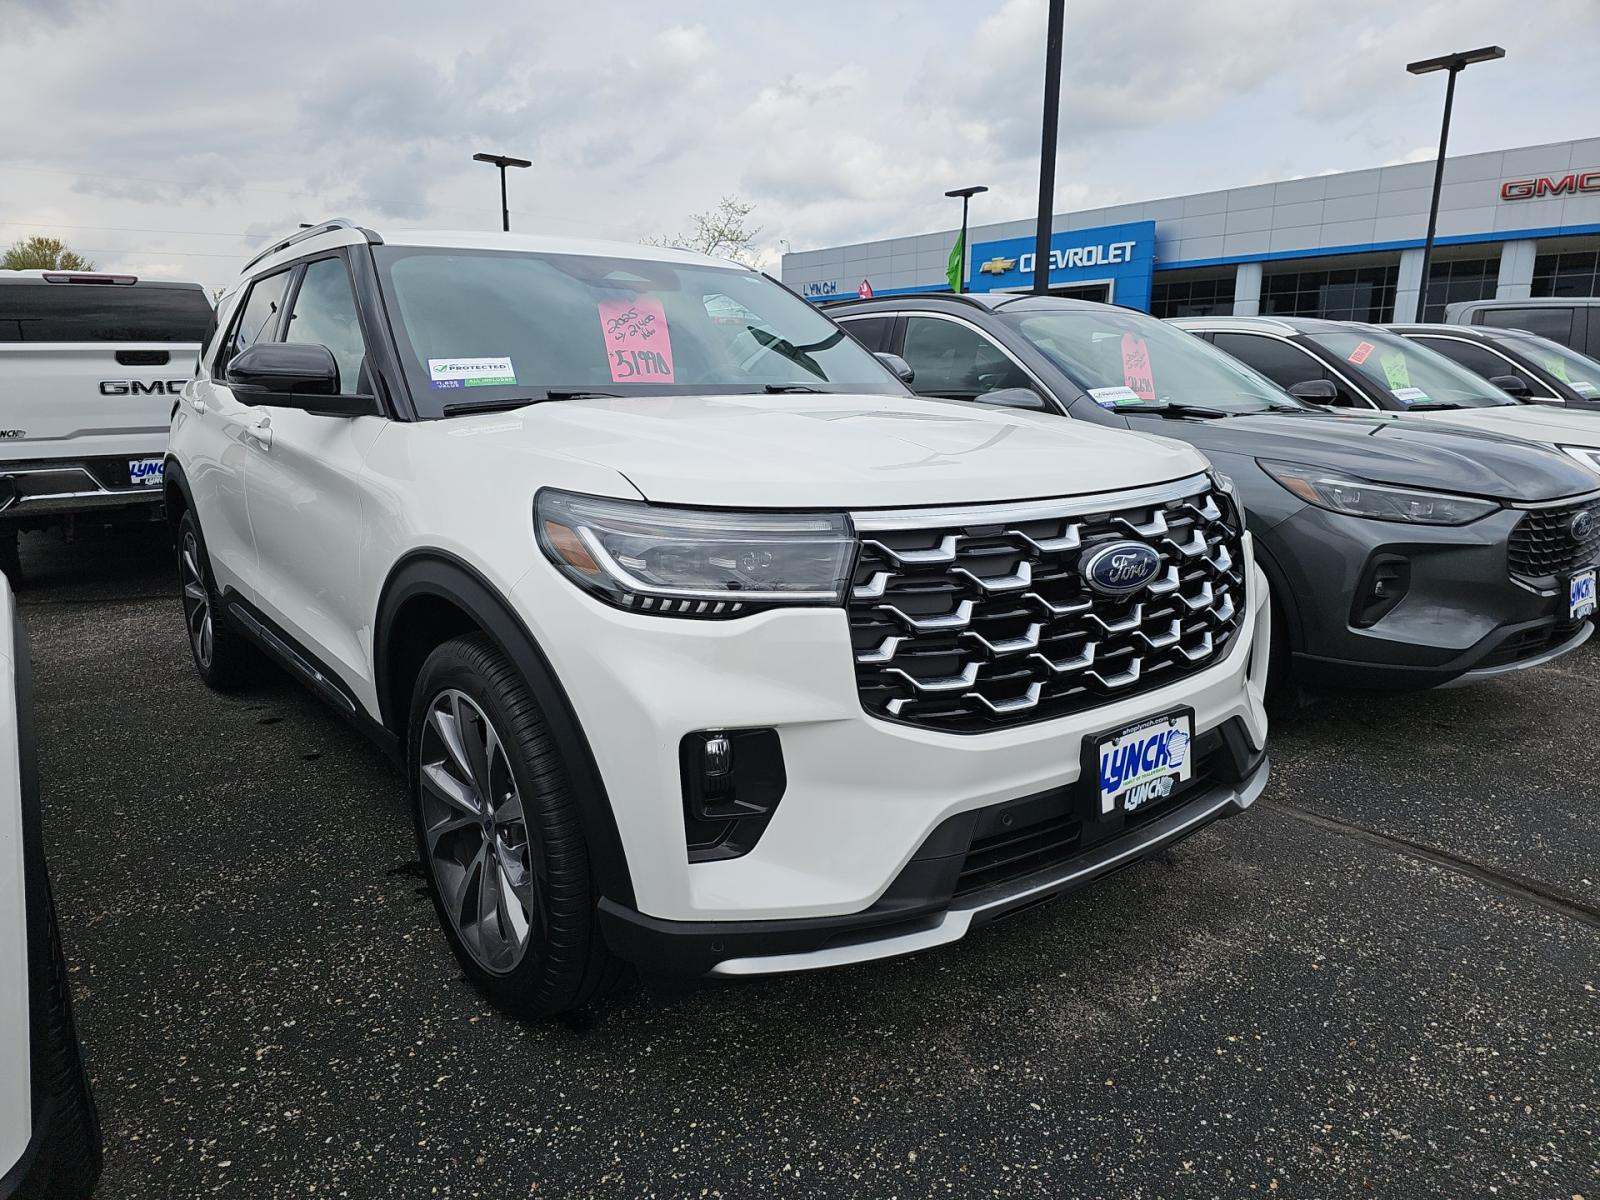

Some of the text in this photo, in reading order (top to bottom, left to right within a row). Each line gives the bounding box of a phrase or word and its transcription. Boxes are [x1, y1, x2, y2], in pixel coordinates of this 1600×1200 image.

[803, 281, 836, 296] LYNCH
[1109, 553, 1149, 582] Ford
[1101, 730, 1172, 794] LYNCH
[1124, 776, 1165, 811] LYNCH
